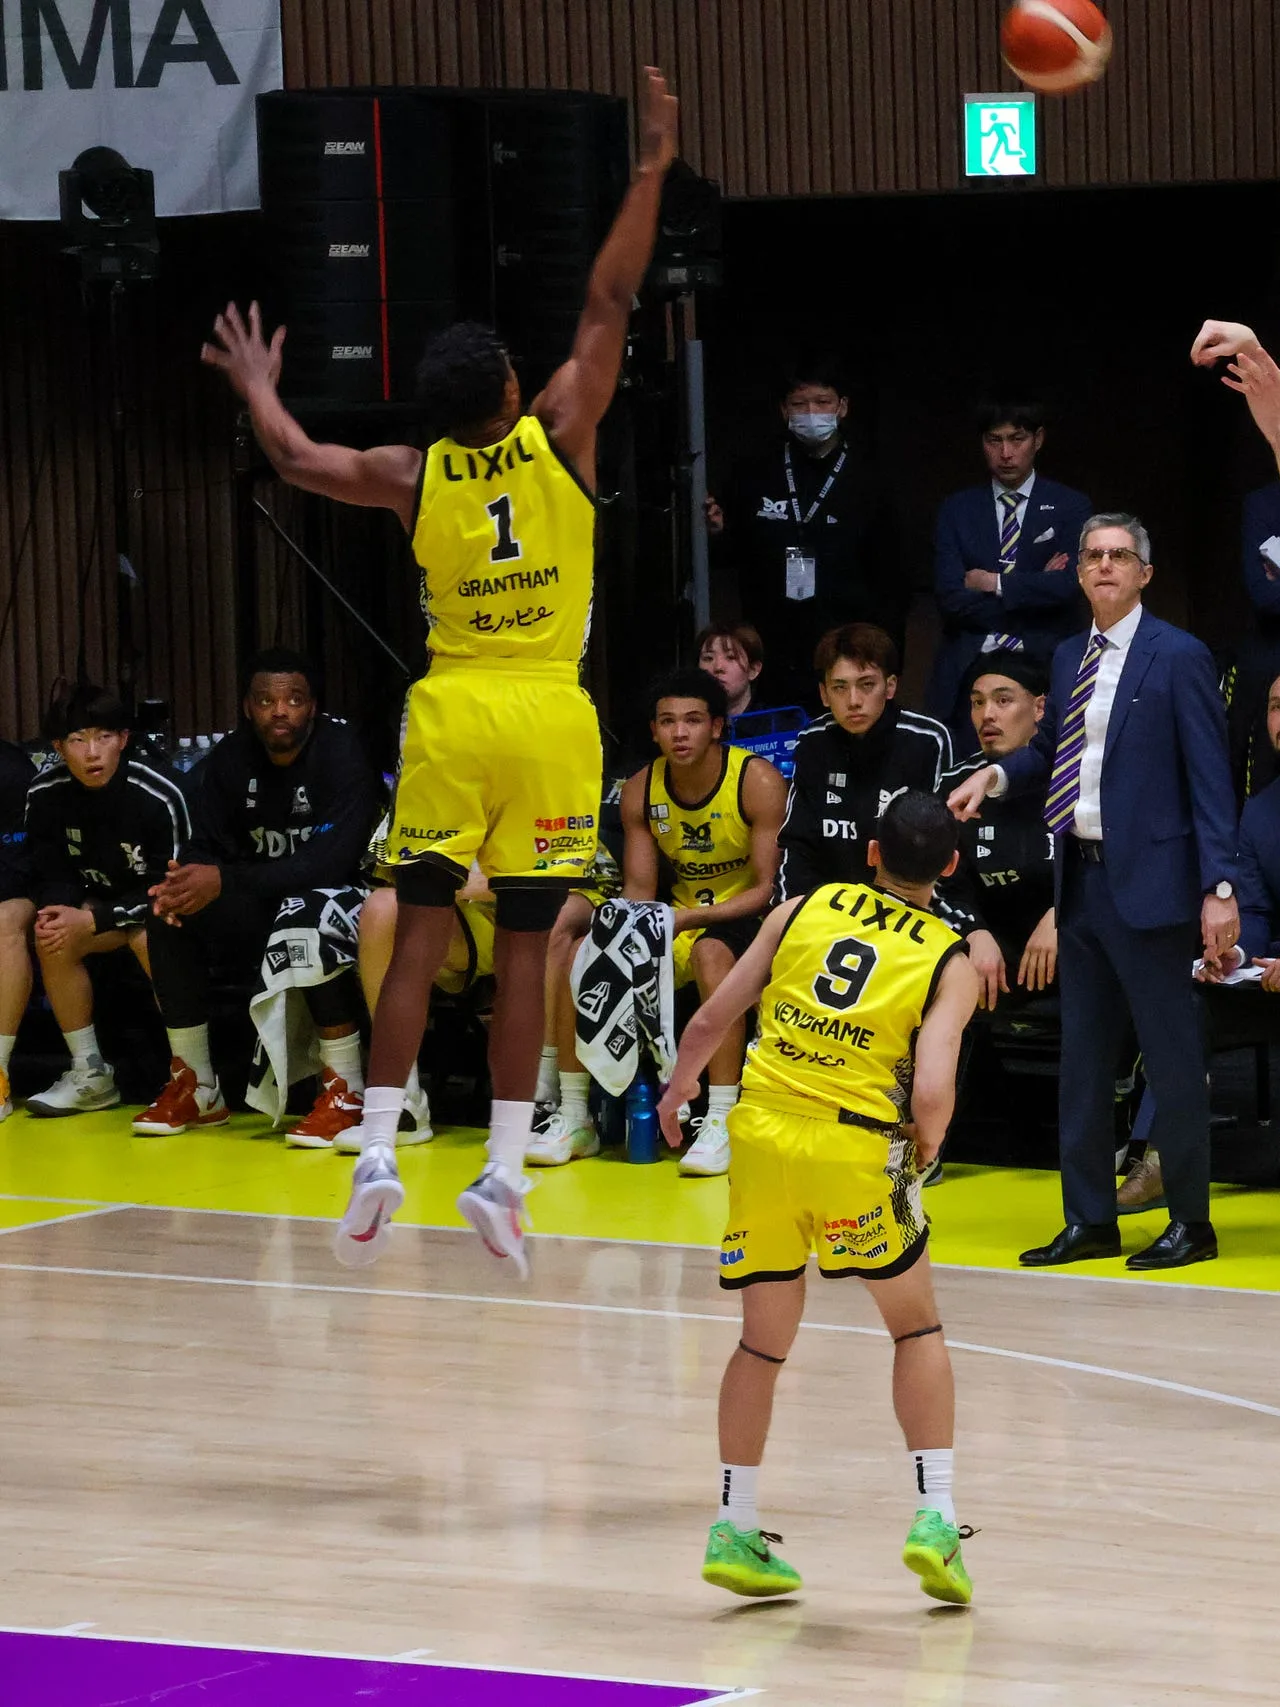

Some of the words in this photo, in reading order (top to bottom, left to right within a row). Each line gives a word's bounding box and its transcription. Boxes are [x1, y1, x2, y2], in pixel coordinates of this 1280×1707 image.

[443, 436, 535, 482] LIXIL
[487, 492, 522, 563] 1
[458, 565, 559, 598] GRANTHAM
[567, 814, 594, 831] ena
[822, 818, 858, 840] DTS
[979, 869, 1020, 887] DTS
[828, 888, 926, 944] LIXIL
[813, 936, 878, 1011] 9
[774, 1001, 875, 1051] VENDRAME
[857, 1205, 883, 1229] ena
